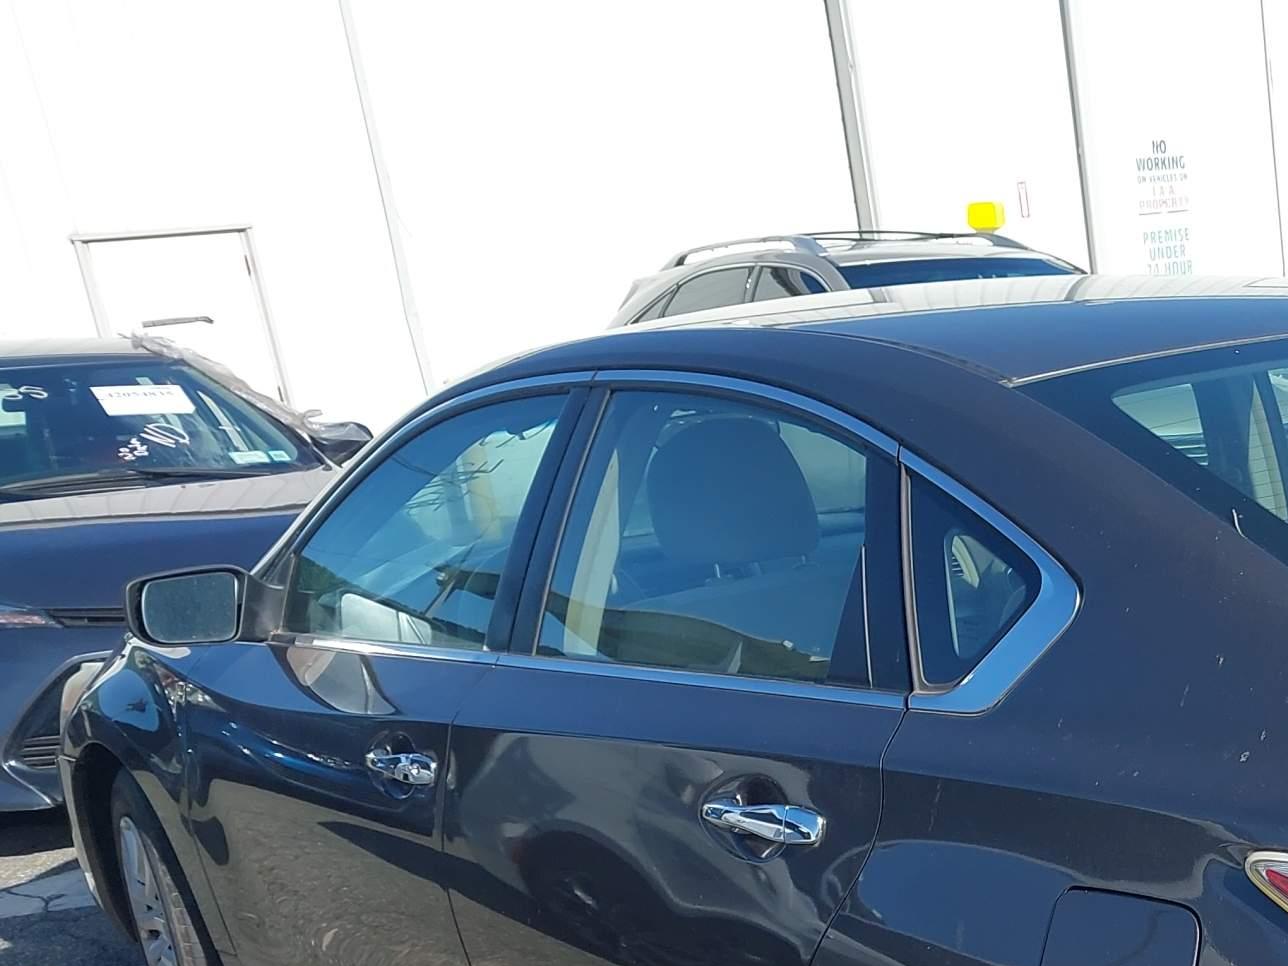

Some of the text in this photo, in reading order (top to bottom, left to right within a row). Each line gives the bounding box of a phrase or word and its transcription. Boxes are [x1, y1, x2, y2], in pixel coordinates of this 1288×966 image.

[1152, 140, 1166, 154] NO
[1136, 156, 1185, 171] WORKING
[1143, 228, 1189, 244] PREMISE
[1149, 245, 1185, 261] UNDER
